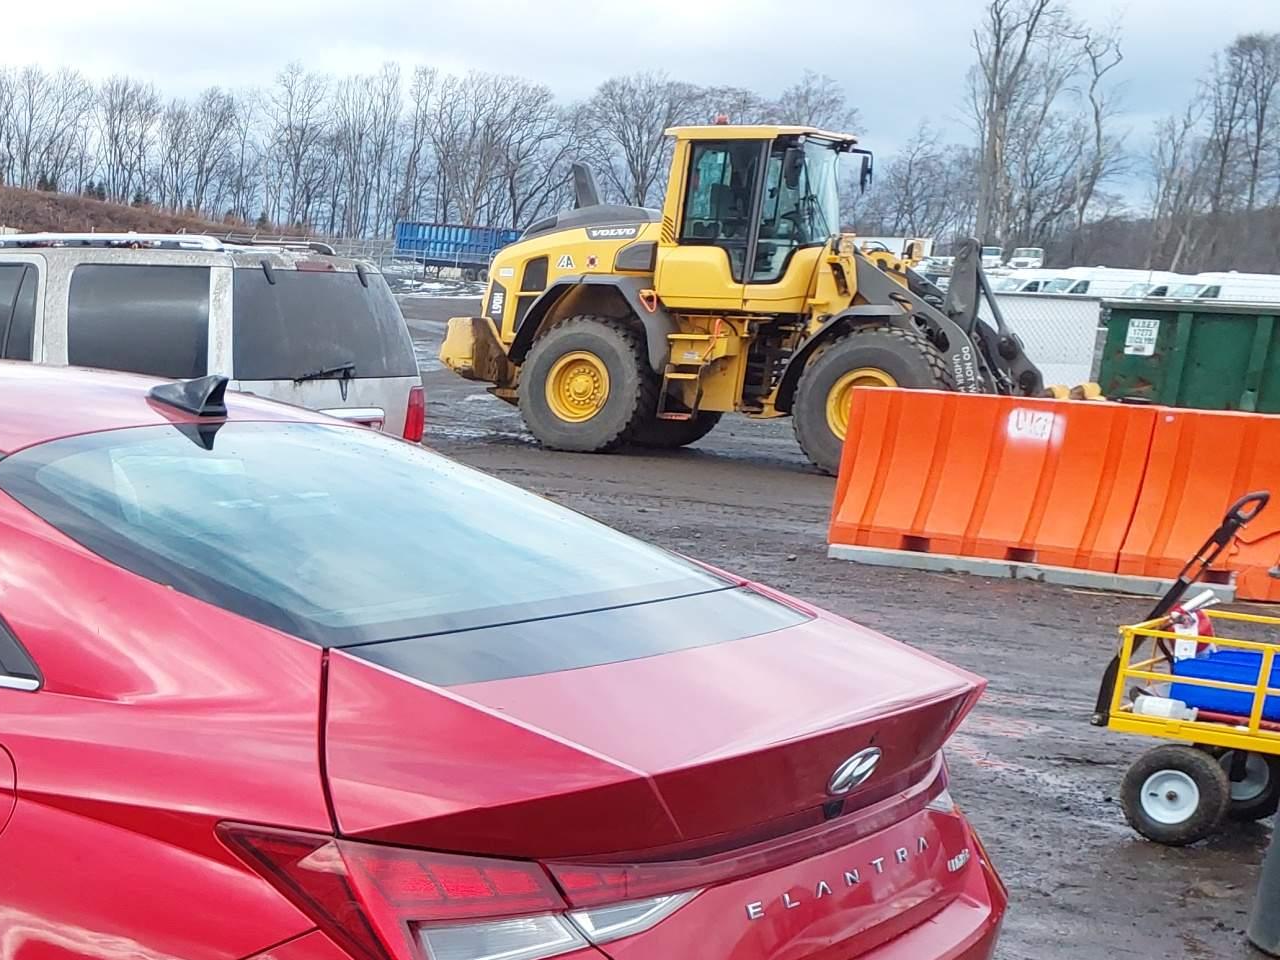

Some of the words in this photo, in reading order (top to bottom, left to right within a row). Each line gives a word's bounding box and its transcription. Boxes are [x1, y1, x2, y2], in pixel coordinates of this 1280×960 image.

[591, 228, 636, 237] VOLVO
[491, 292, 505, 314] L90H
[962, 346, 971, 361] DO
[964, 362, 975, 381] NOT
[746, 837, 929, 920] ELANTRA
